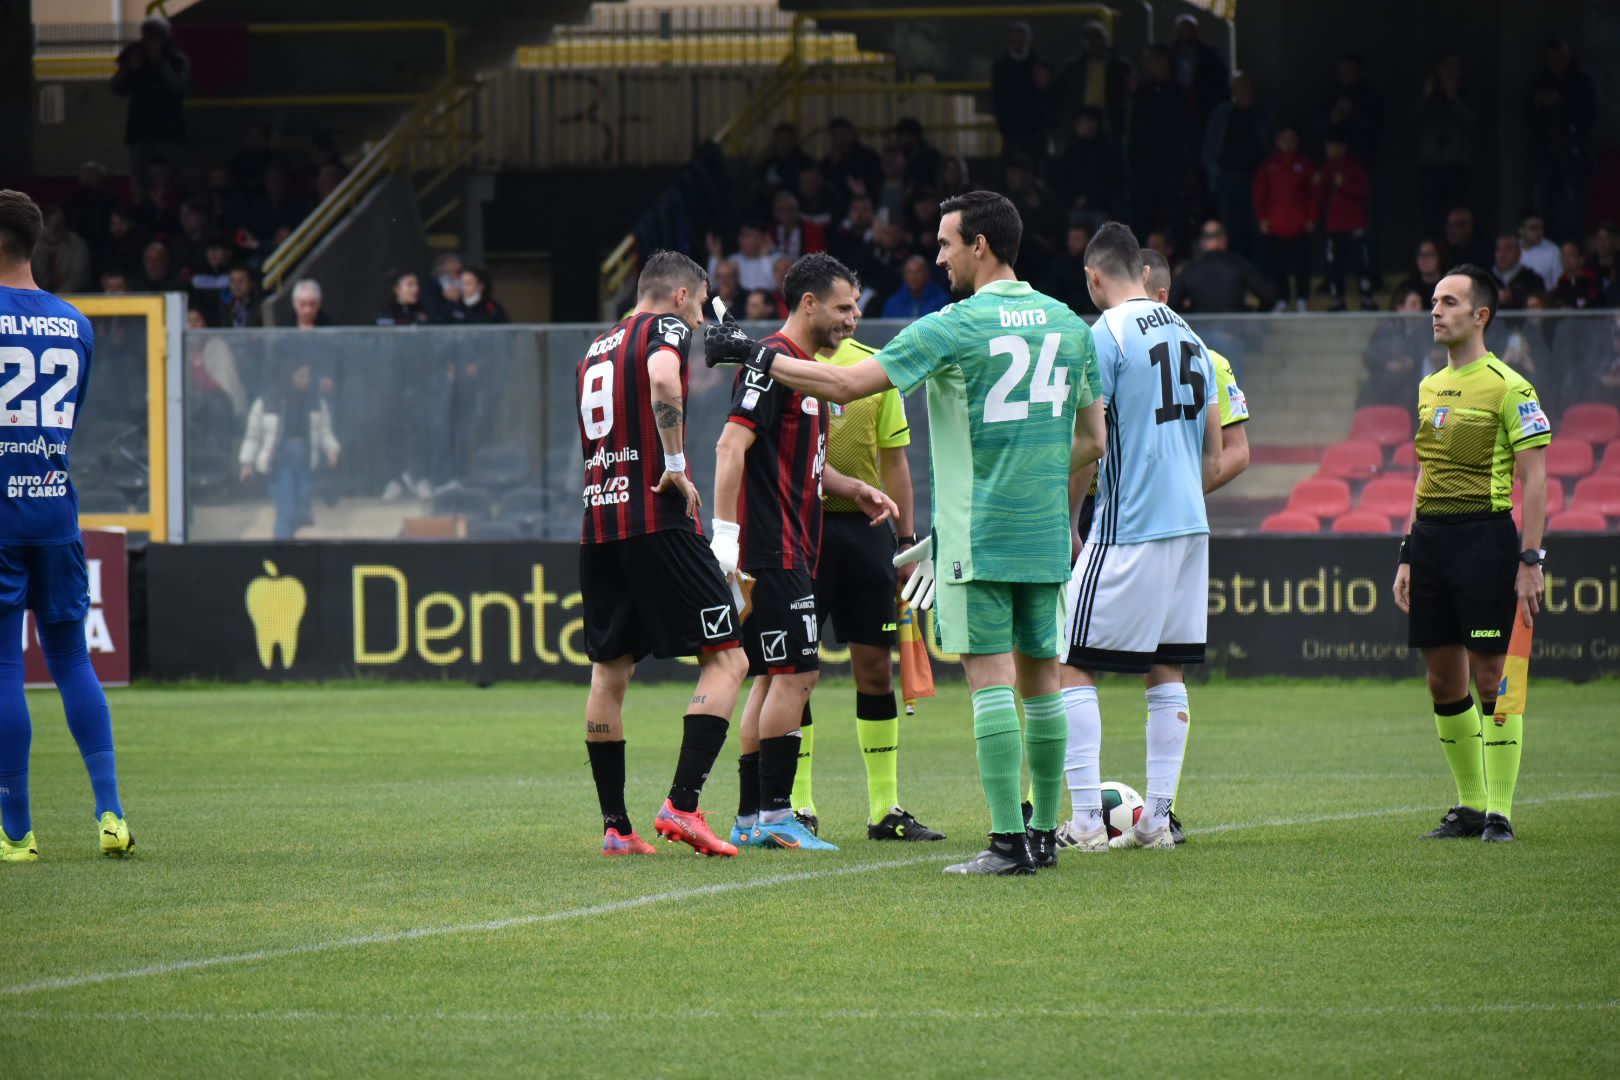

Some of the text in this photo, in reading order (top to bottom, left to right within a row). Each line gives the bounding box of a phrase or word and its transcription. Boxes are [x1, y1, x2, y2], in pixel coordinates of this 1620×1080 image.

[0, 315, 79, 339] ALMASSO
[1000, 306, 1047, 328] borra
[0, 346, 79, 429] 22
[983, 332, 1071, 423] 24
[1149, 340, 1205, 425] 15
[581, 360, 614, 441] 8
[8, 475, 42, 486] AUTO
[8, 485, 67, 498] DI CARLO
[591, 491, 630, 507] CARLO
[1208, 566, 1377, 615] studio
[352, 563, 592, 666] Denta
[1471, 630, 1501, 638] LEGEA
